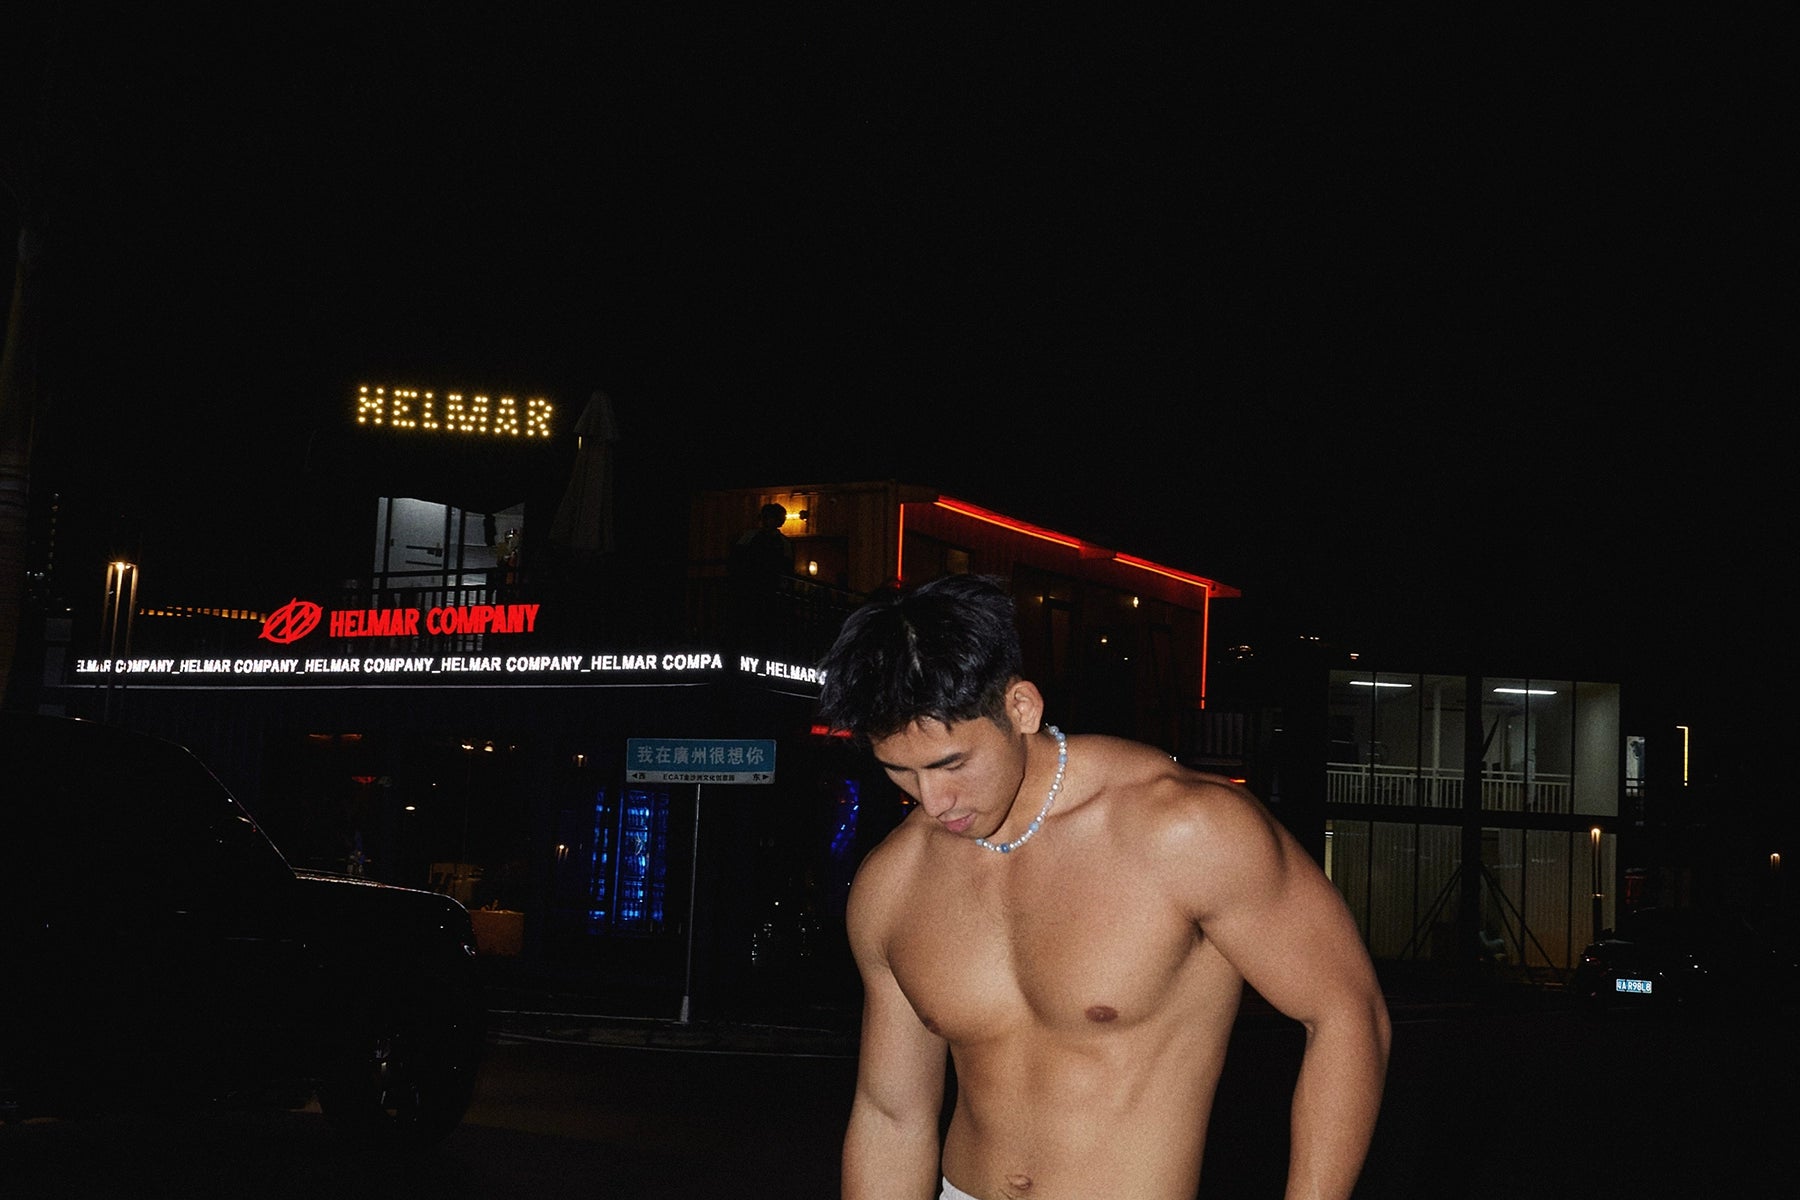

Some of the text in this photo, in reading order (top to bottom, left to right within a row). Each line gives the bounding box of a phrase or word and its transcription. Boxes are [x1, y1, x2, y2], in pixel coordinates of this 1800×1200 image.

[358, 386, 553, 437] HELMAR
[329, 604, 540, 637] HELMAR COMPANY
[661, 653, 723, 671] COMPA
[637, 745, 764, 765] 我在廣州很想你
